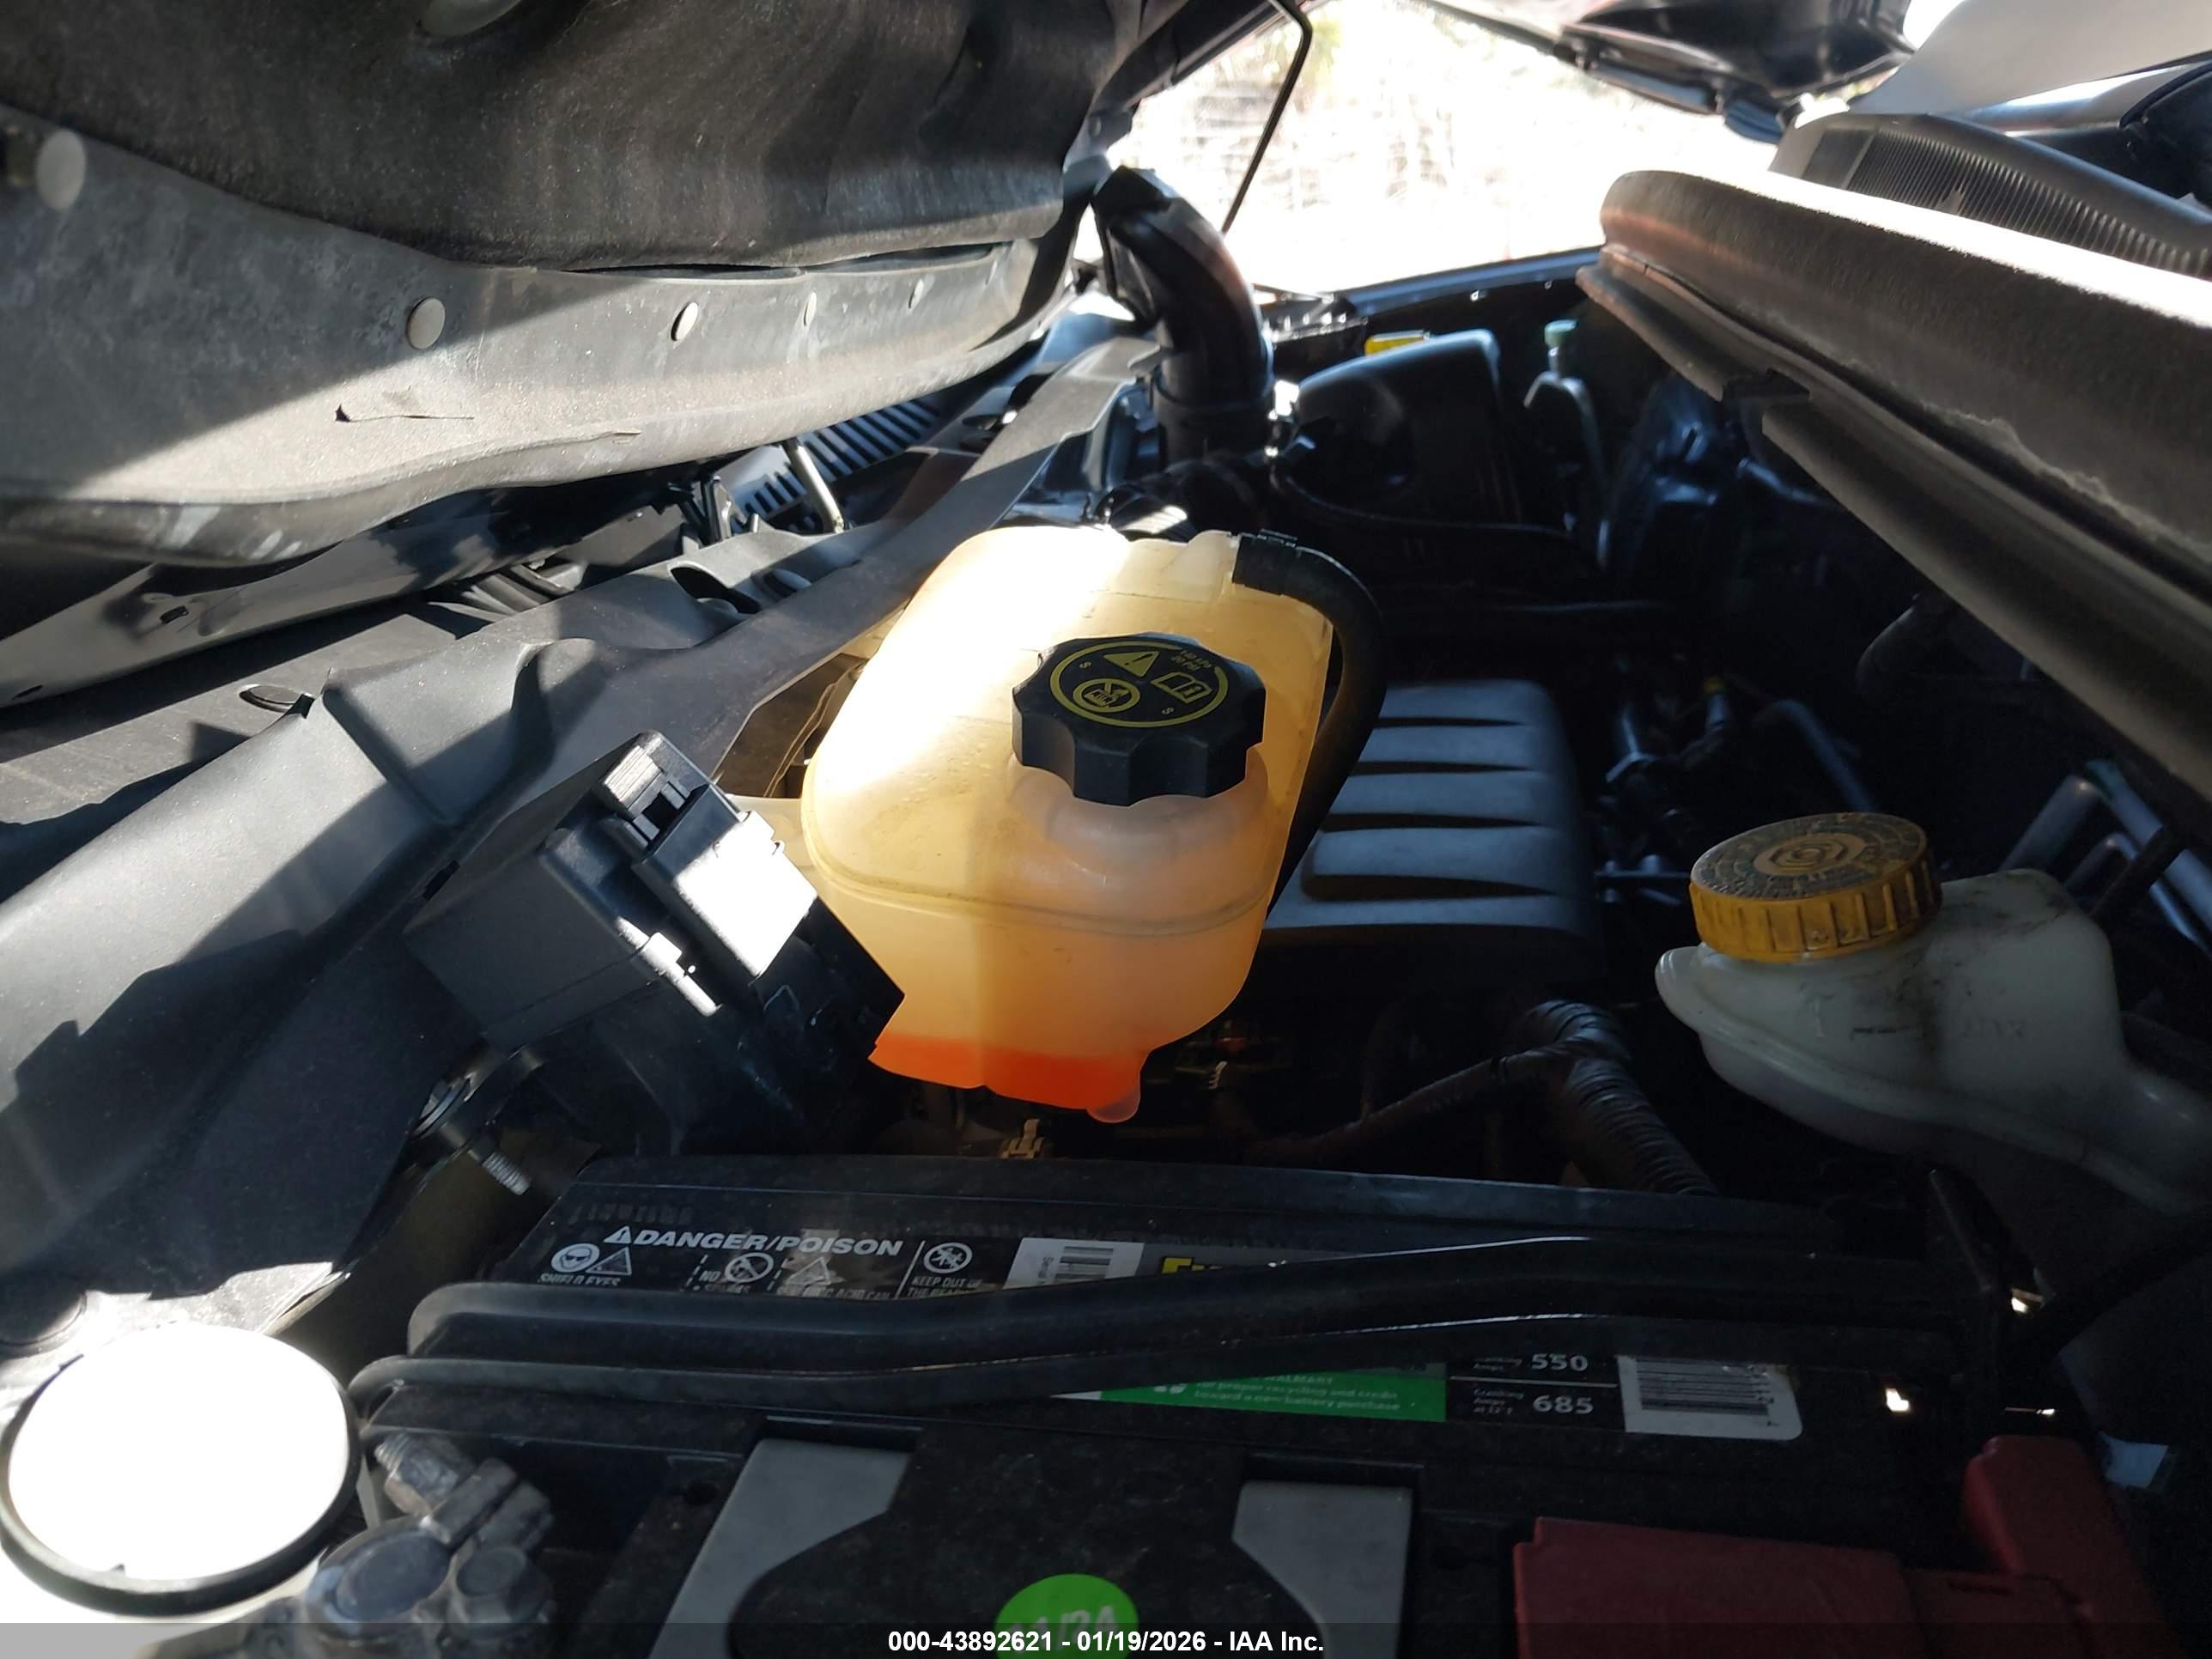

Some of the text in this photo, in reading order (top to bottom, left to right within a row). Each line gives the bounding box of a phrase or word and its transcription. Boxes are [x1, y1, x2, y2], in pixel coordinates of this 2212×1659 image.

[632, 1231, 902, 1256] DANGER/POISON
[699, 1271, 721, 1283] NO
[911, 1276, 942, 1288] KEEP
[941, 1277, 966, 1289] OUT
[1531, 1353, 1589, 1373] 550
[1532, 1395, 1595, 1416] 685
